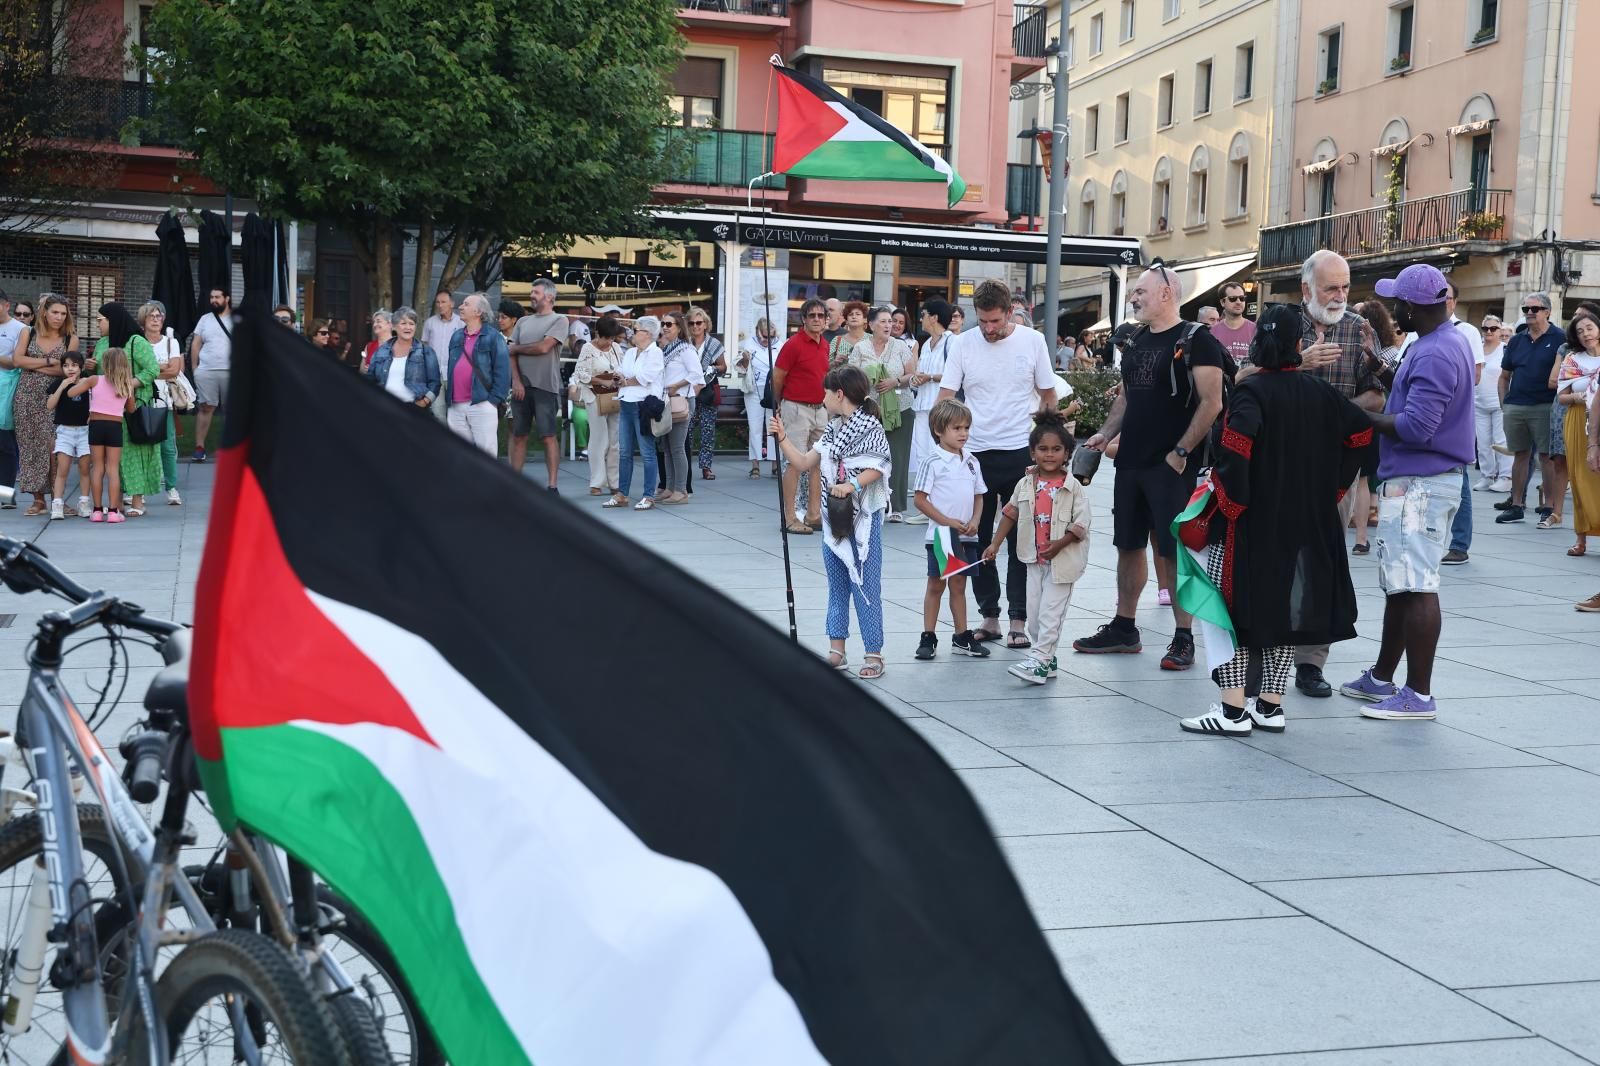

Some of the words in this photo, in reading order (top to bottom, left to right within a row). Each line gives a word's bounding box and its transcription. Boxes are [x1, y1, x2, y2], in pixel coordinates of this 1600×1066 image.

[106, 210, 152, 221] Carmen
[945, 243, 969, 251] Picantes
[31, 747, 69, 947] LAPIER
